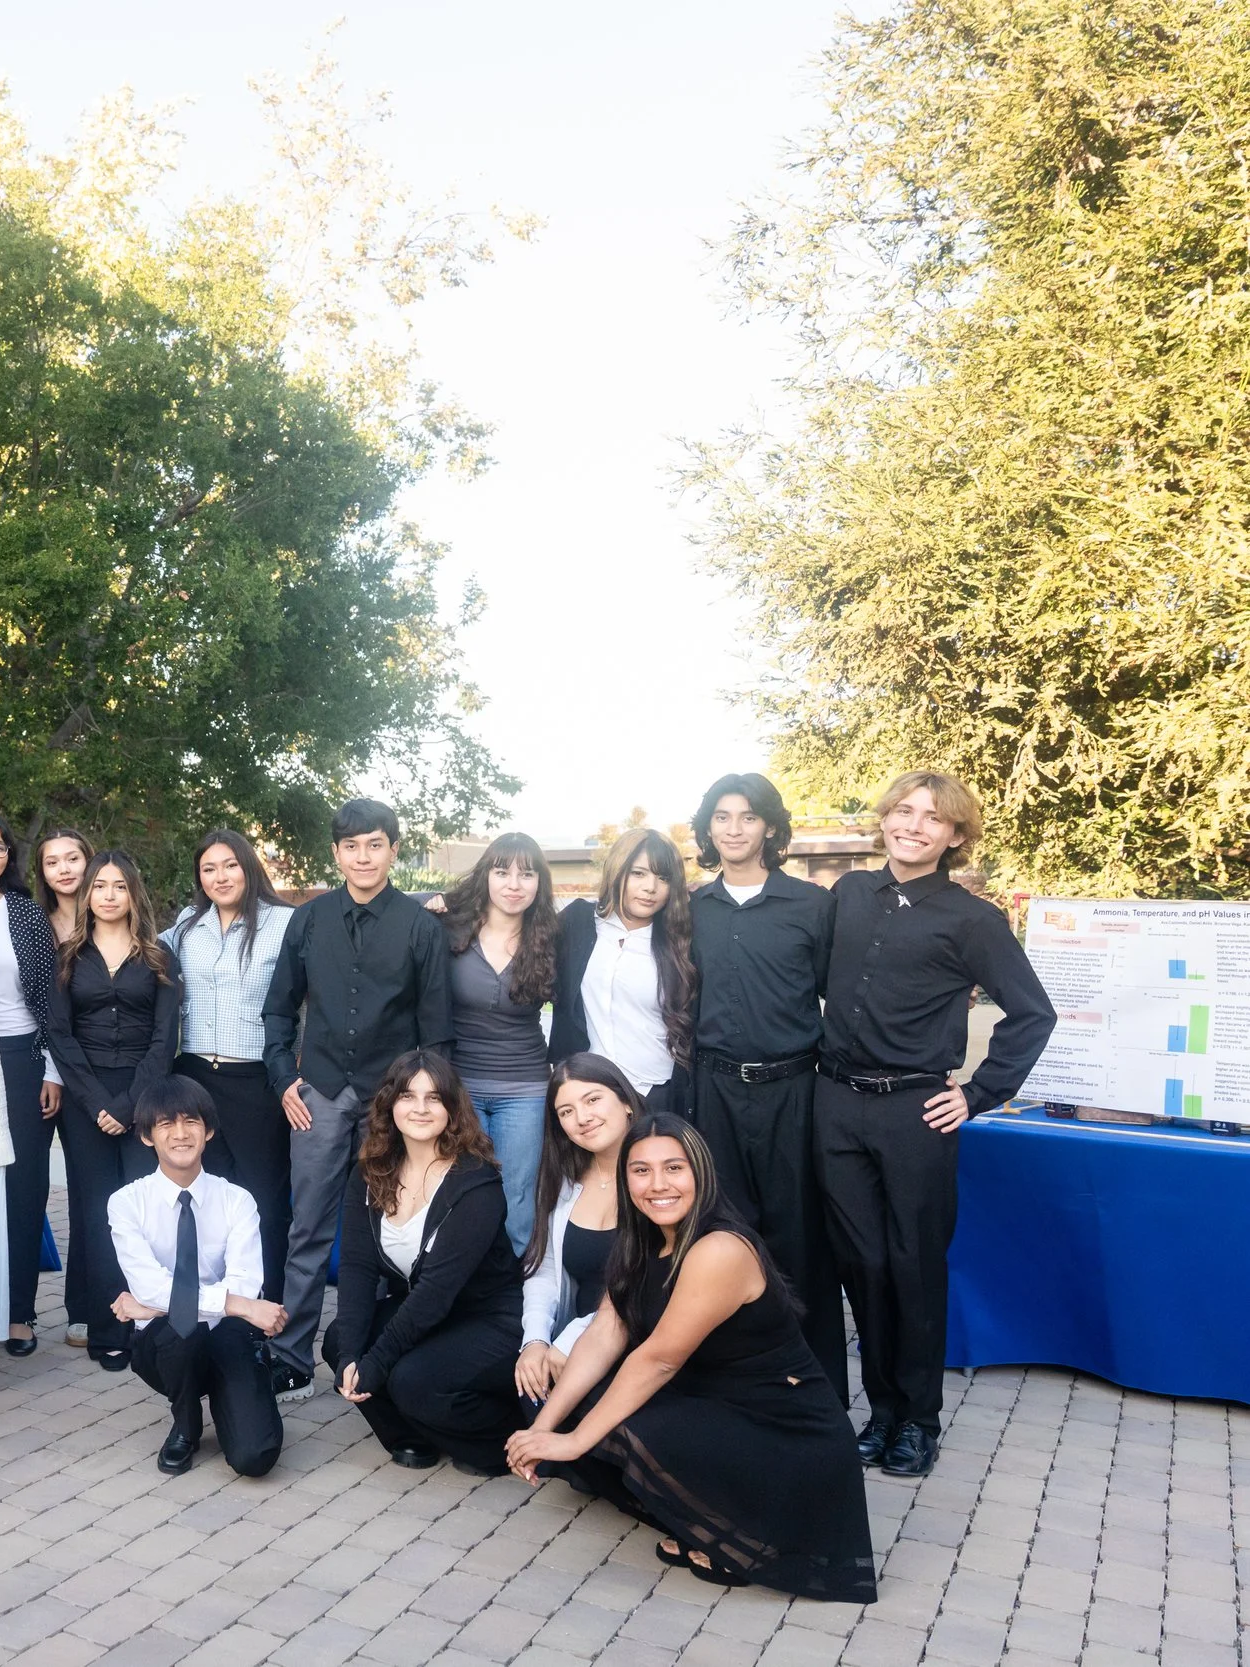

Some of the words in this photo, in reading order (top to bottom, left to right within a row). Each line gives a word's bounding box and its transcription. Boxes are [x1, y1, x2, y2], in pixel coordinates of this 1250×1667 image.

[1093, 908, 1130, 918] Ammonia,
[1132, 909, 1180, 918] Temperature,
[1198, 910, 1210, 919] pH
